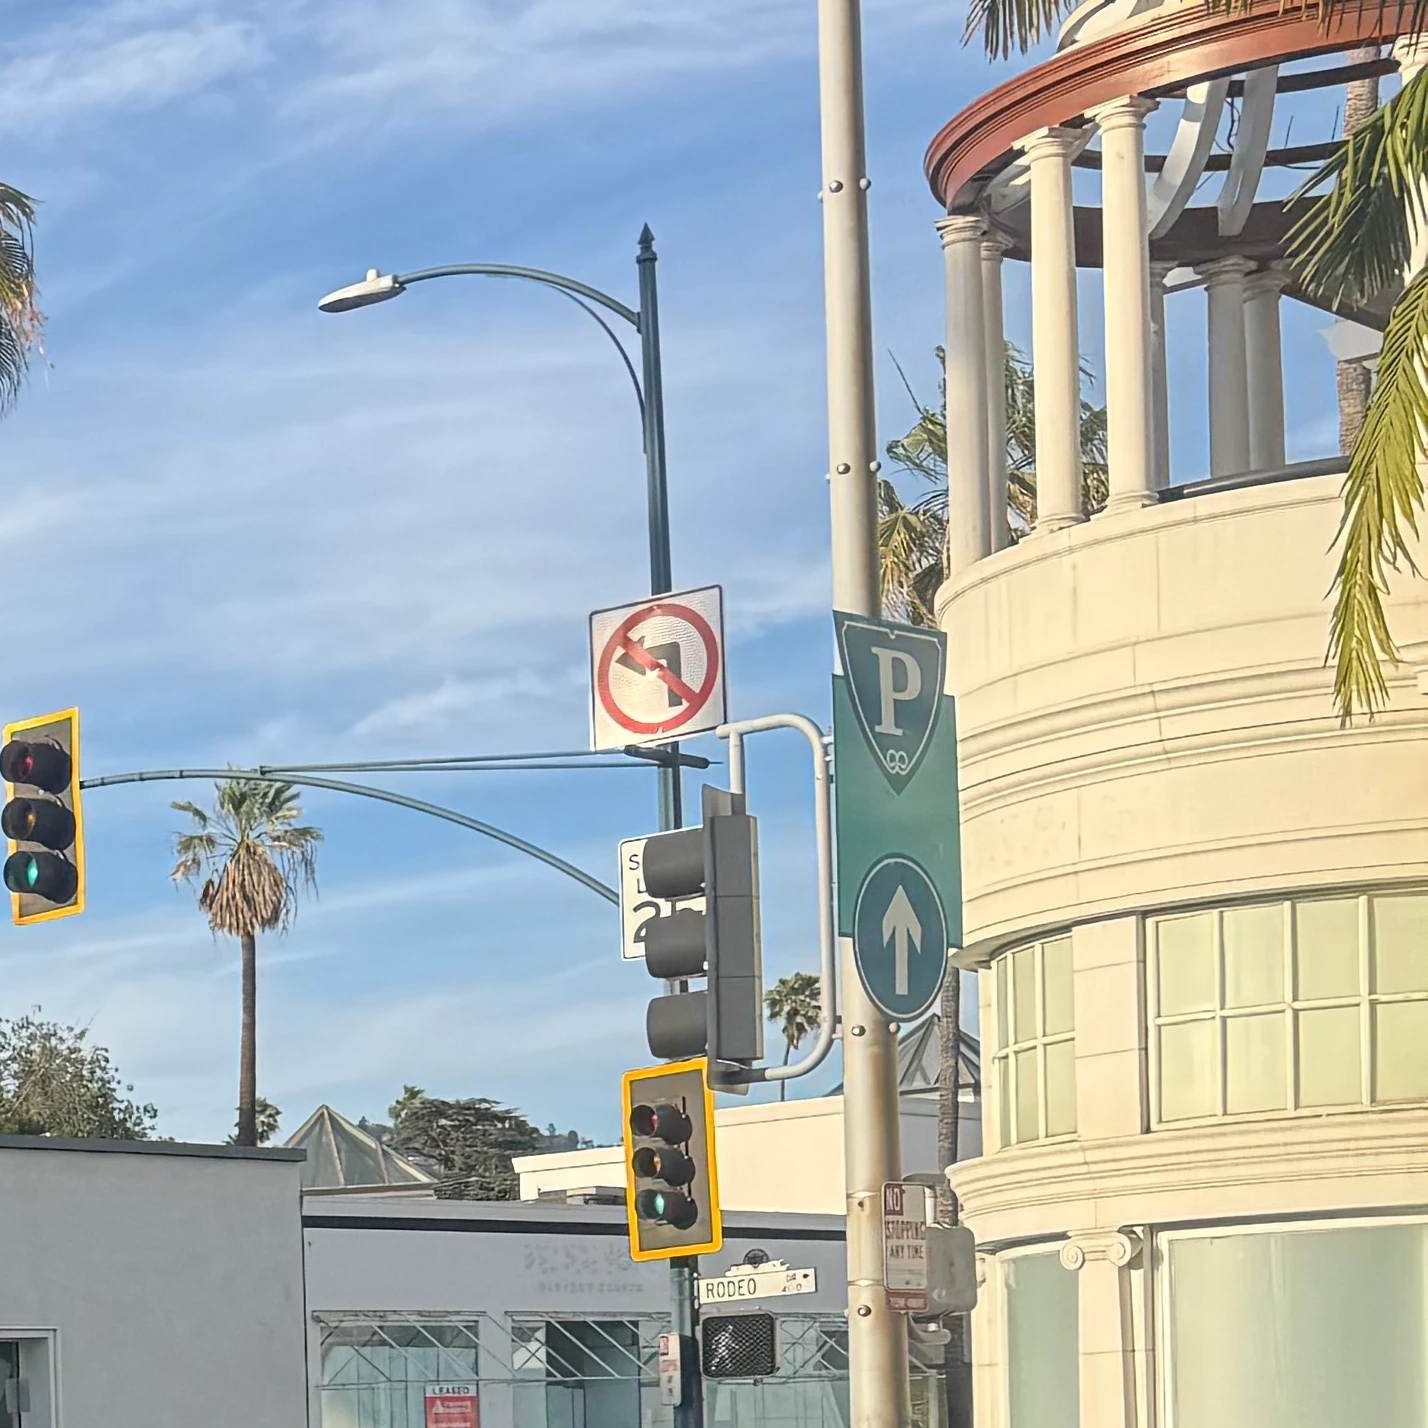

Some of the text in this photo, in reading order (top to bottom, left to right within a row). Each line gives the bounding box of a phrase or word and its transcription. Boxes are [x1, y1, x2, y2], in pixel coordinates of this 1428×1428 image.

[871, 647, 921, 736] P
[886, 1188, 901, 1210] NO
[890, 1245, 924, 1258] ANY TIME
[706, 1278, 757, 1298] RODEO
[781, 1283, 802, 1292] 40
